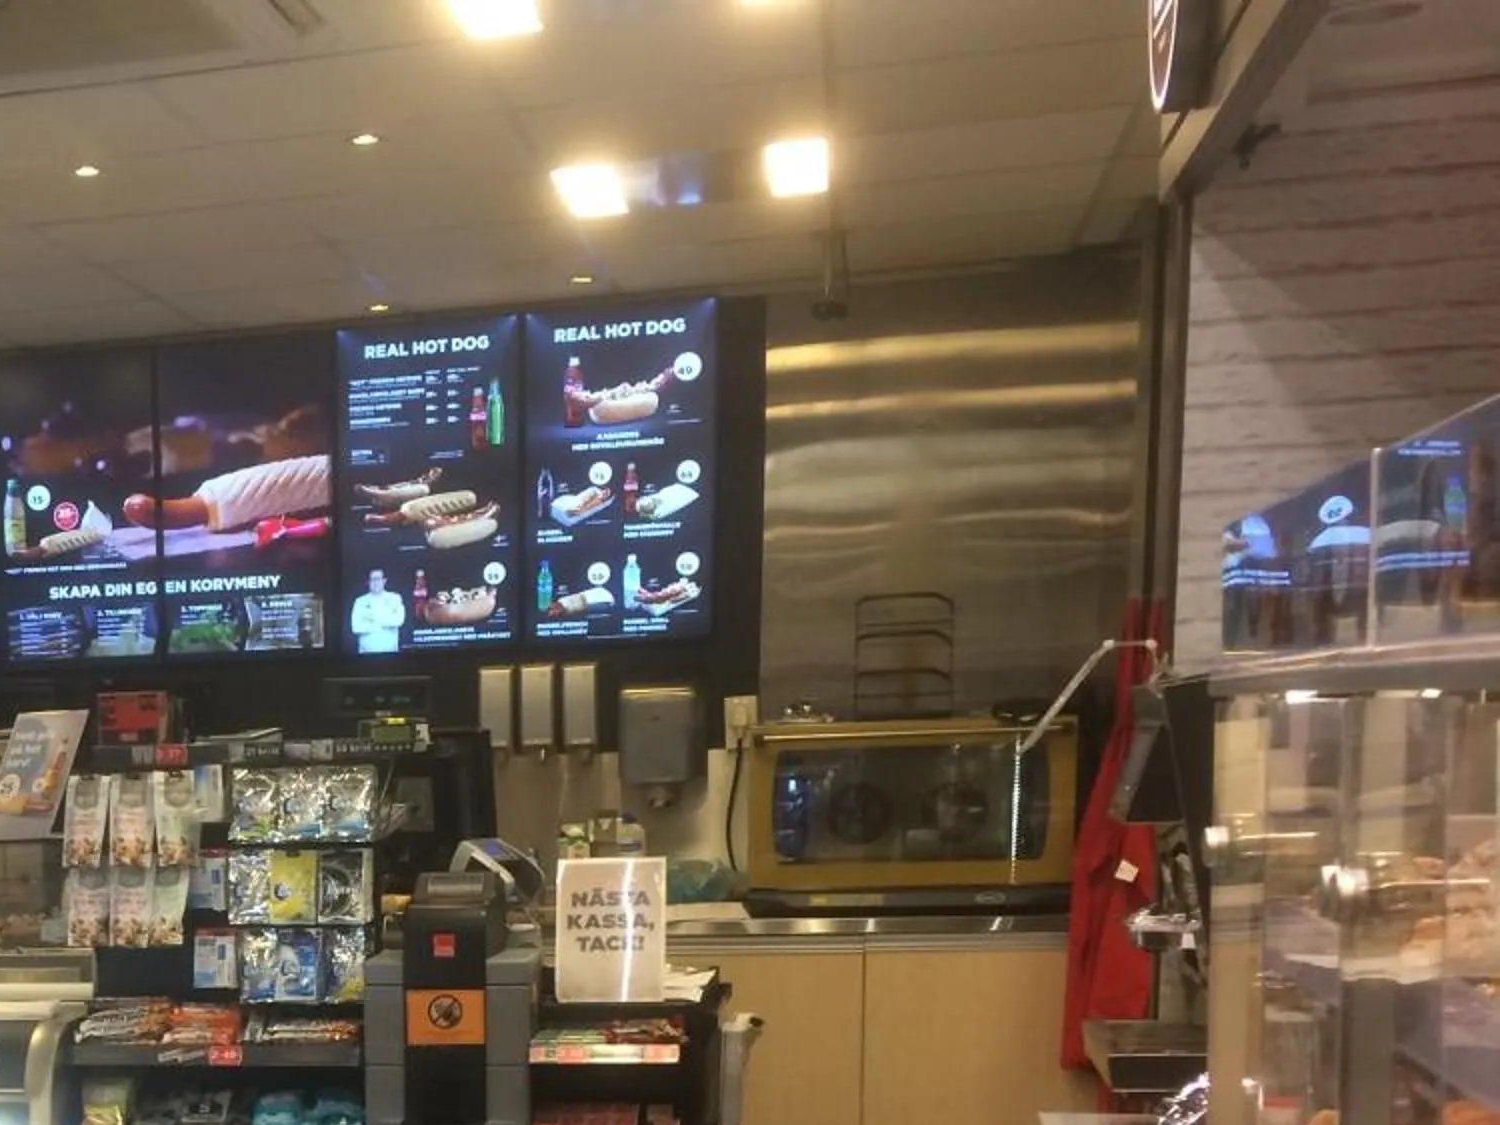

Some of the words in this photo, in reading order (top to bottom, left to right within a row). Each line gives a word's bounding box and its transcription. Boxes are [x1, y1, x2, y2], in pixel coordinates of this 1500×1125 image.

[554, 326, 601, 343] REAL
[605, 321, 642, 339] HOT
[646, 318, 686, 335] DOG
[364, 343, 409, 359] REAL
[412, 338, 448, 355] HOT
[452, 335, 490, 351] DOG
[50, 584, 101, 599] SKAPA
[105, 582, 132, 597] DIN
[190, 574, 281, 592] KORVMENY
[571, 887, 650, 907] NÄSTA
[567, 913, 655, 931] KASSA,
